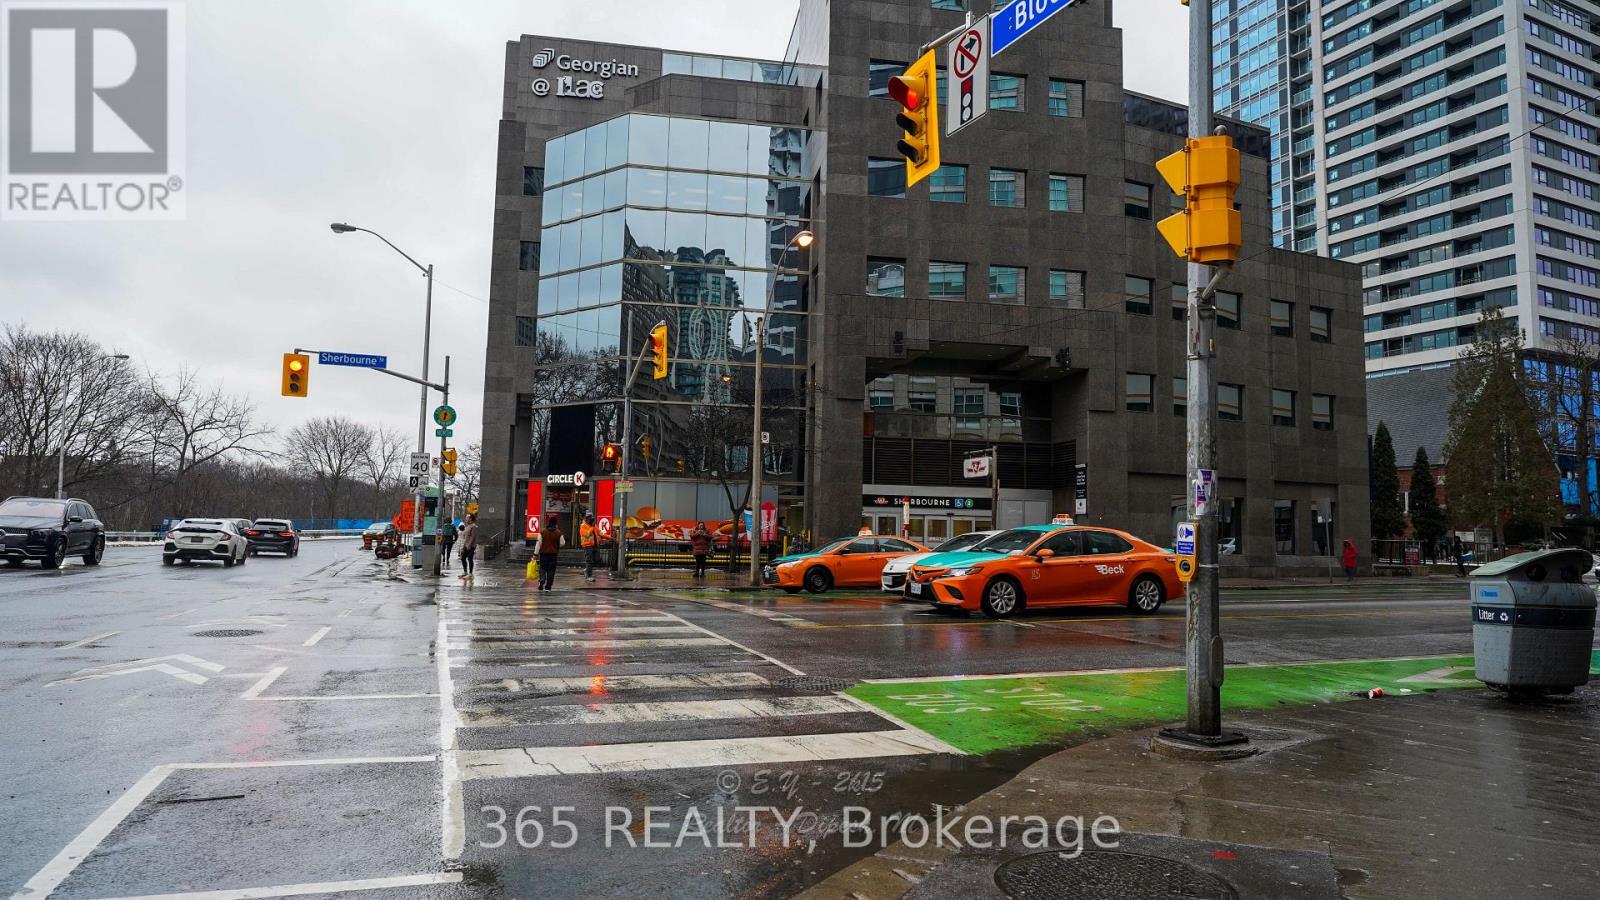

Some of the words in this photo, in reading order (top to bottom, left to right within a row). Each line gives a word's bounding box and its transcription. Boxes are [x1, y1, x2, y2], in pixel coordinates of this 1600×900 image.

[1015, 0, 1059, 30] Blo
[556, 54, 639, 79] Georgian
[321, 352, 378, 365] Sherbourne
[412, 462, 428, 472] 40
[547, 474, 573, 484] CIRCLE
[894, 498, 950, 506] SHRBOURNE
[1101, 564, 1125, 575] Beck
[1479, 609, 1495, 620] Litter
